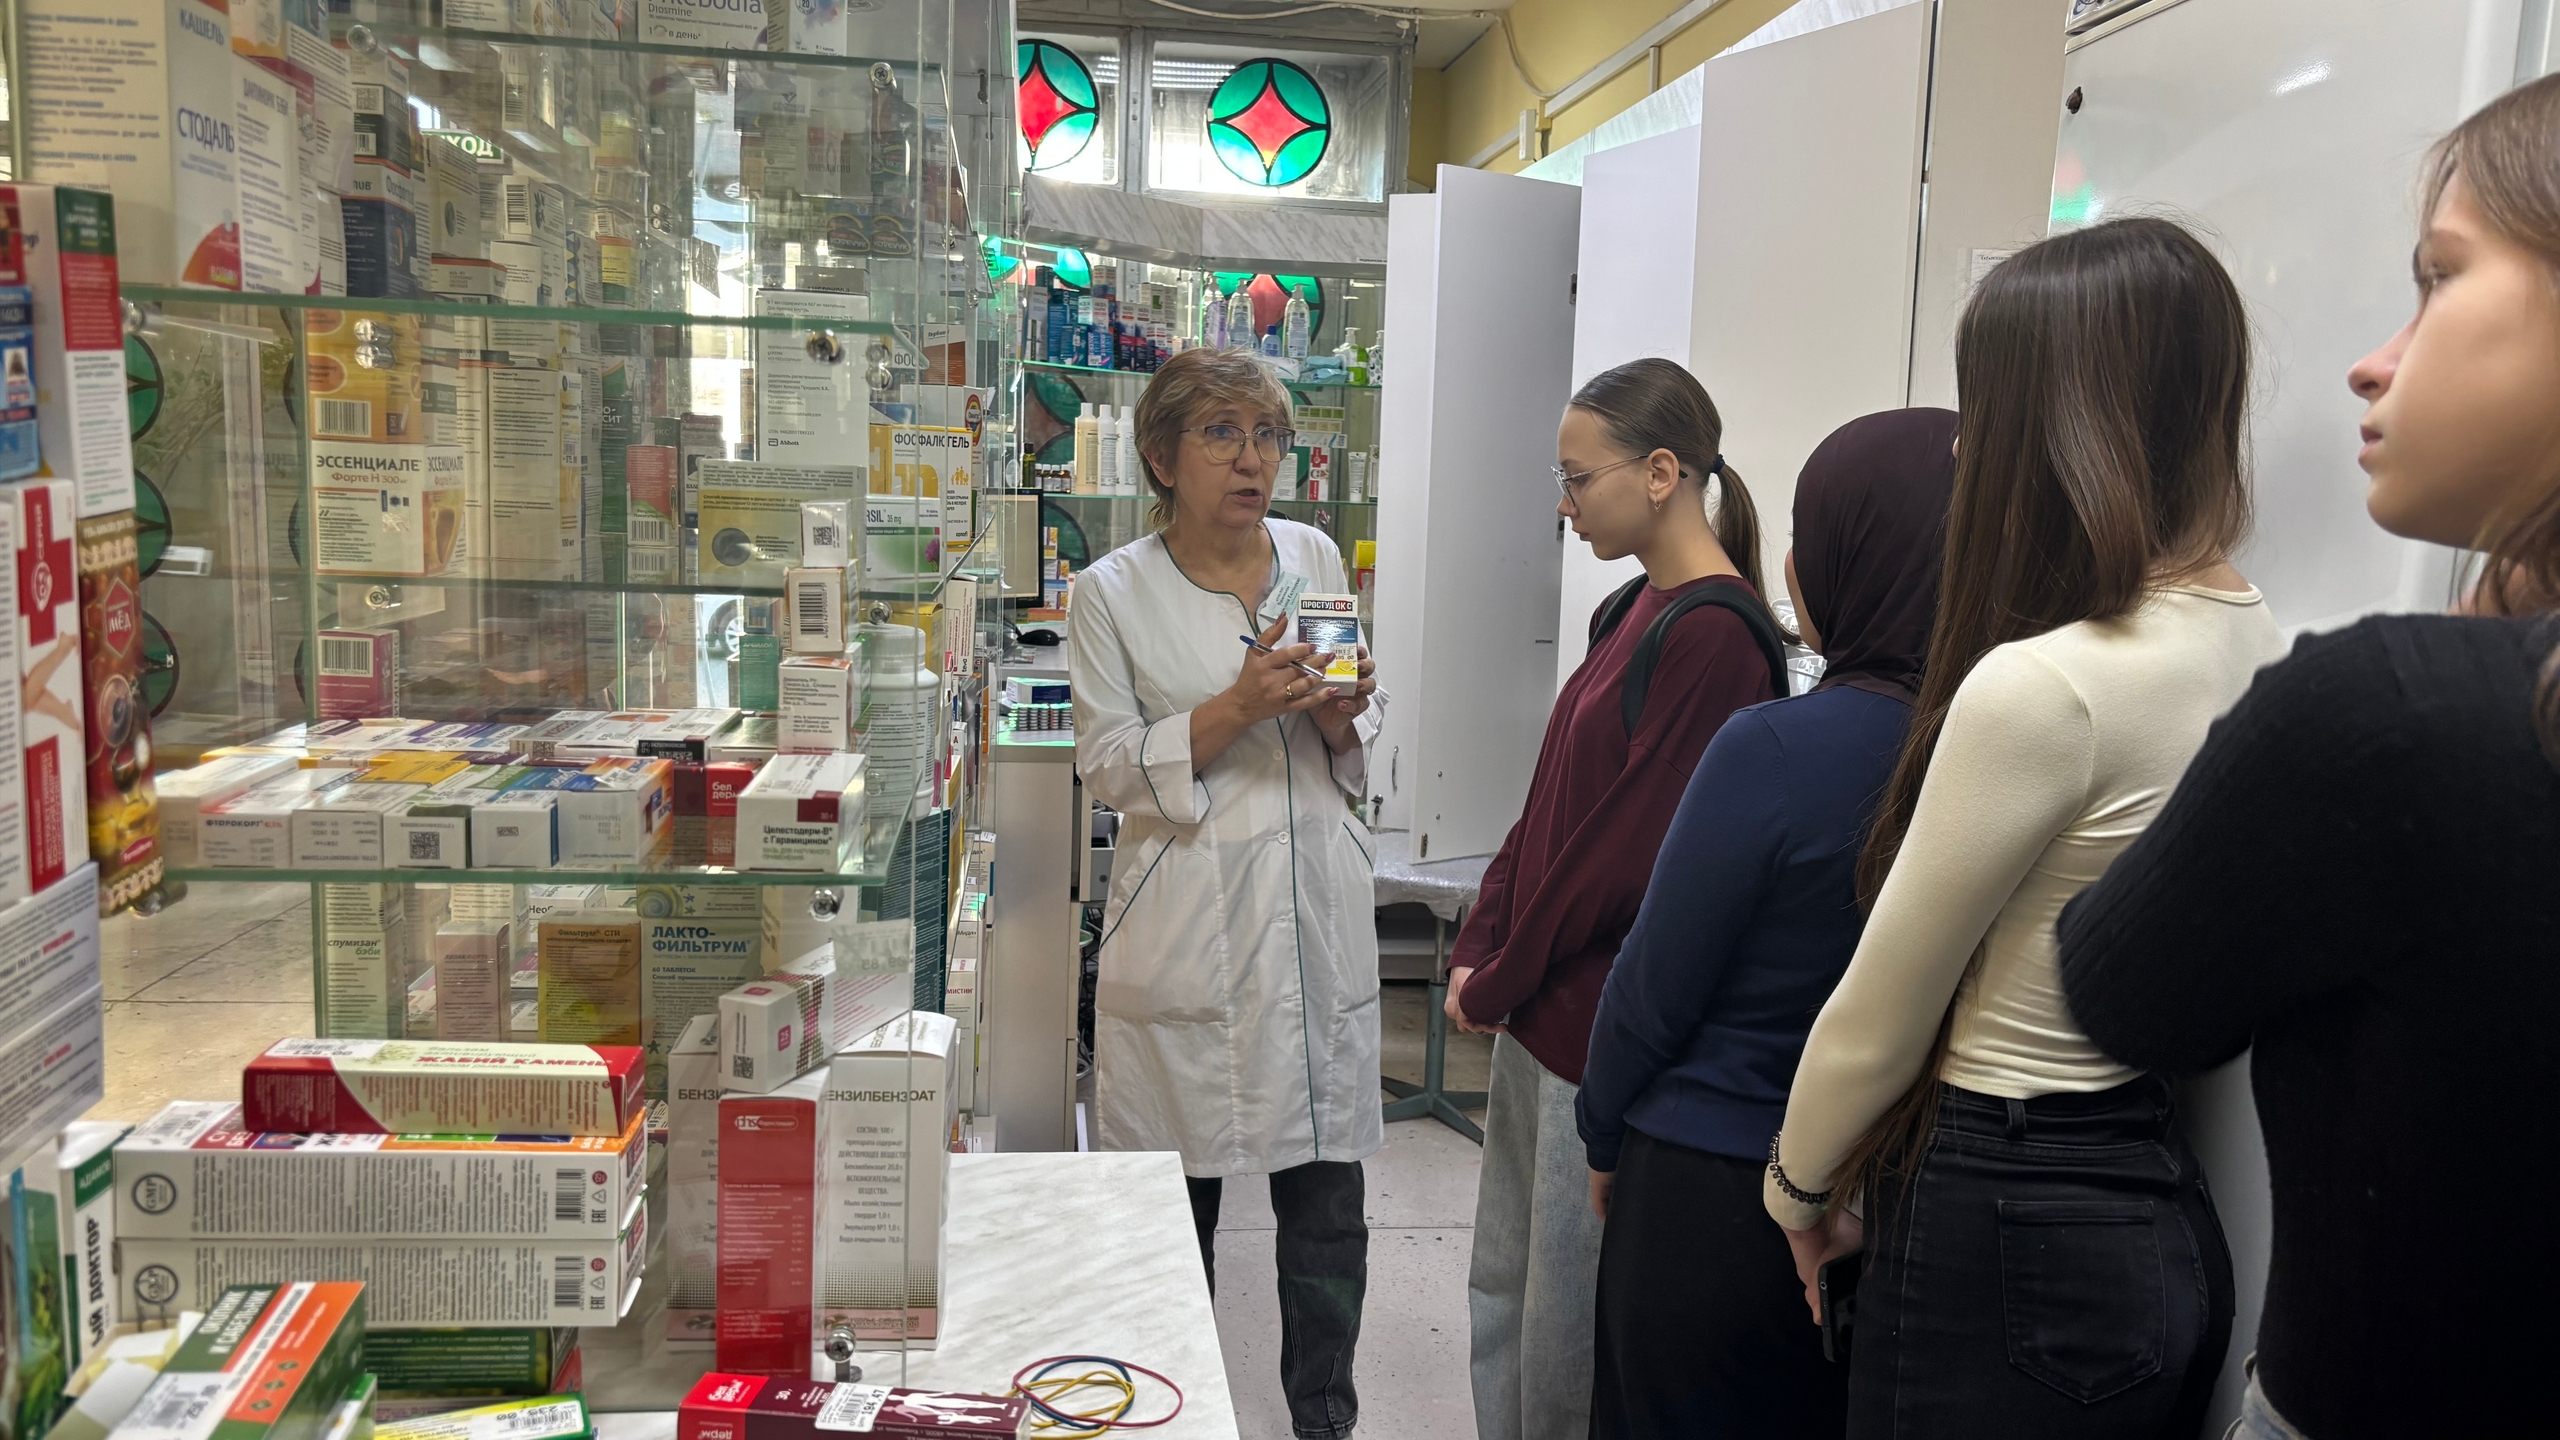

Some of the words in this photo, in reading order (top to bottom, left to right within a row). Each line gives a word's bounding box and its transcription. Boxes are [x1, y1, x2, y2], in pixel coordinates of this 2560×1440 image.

[648, 4, 693, 17] Diosmine
[179, 9, 225, 46] КАШЕЛЬ
[177, 107, 235, 153] СТОДАЛЬ
[445, 134, 494, 157] ХОД
[316, 455, 420, 472] ЭССЕНЦИАЛЕ
[331, 472, 369, 484] Форте
[370, 474, 380, 483] Н
[381, 476, 400, 484] 300
[894, 515, 902, 524] mg
[712, 782, 732, 790] бел
[820, 812, 830, 820] 30
[652, 926, 716, 938] ЛАКТО-
[780, 1031, 790, 1042] 25
[416, 1056, 507, 1066] ЖАБИЙ
[86, 1217, 106, 1304] ДОКТОР
